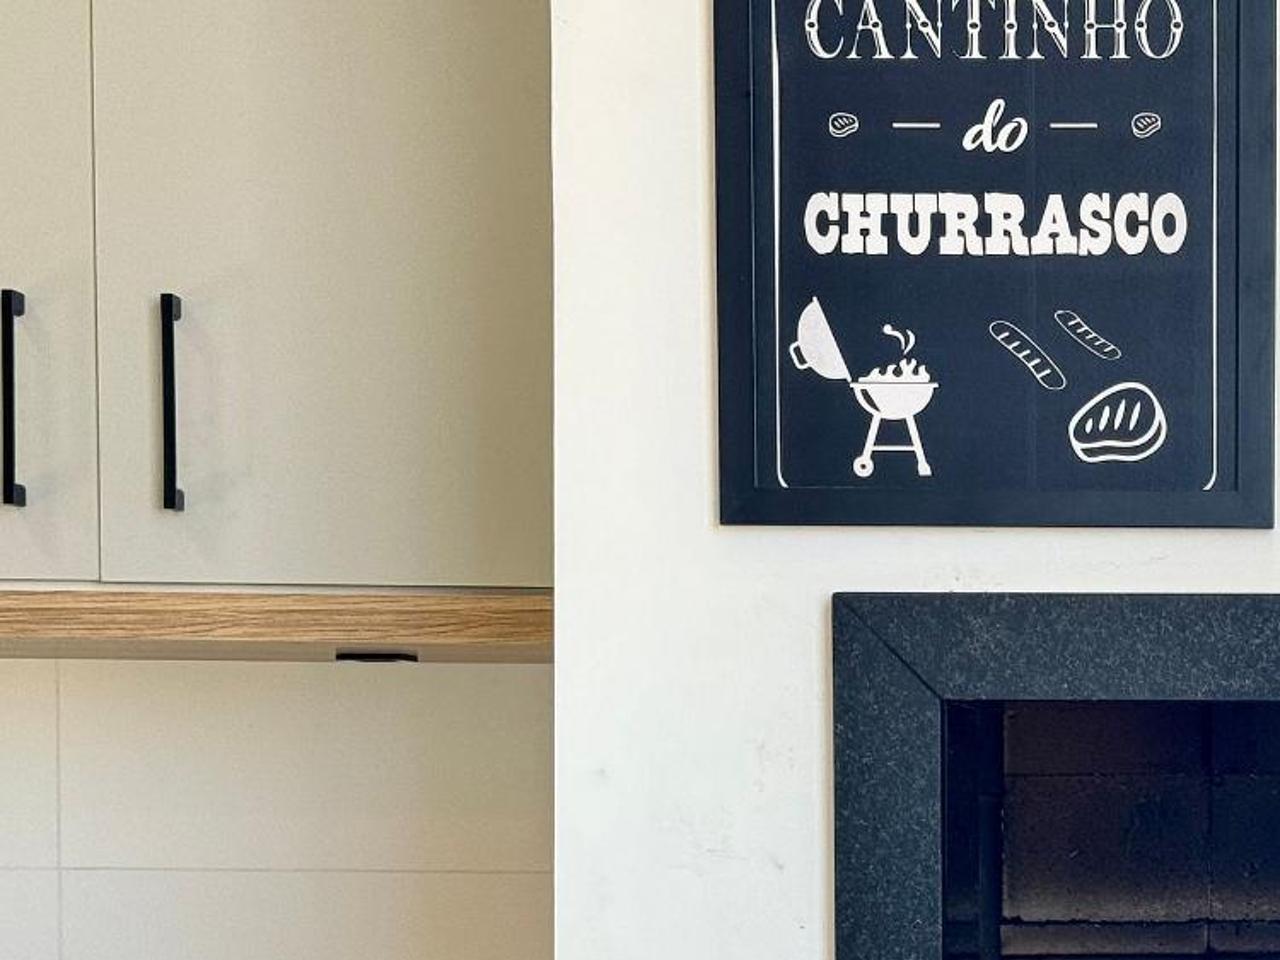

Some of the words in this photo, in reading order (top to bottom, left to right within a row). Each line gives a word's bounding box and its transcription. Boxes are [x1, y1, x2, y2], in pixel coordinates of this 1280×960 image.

[804, 0, 1184, 60] CANTINHO
[962, 98, 1028, 153] do
[803, 191, 1188, 256] CHURRASCO
